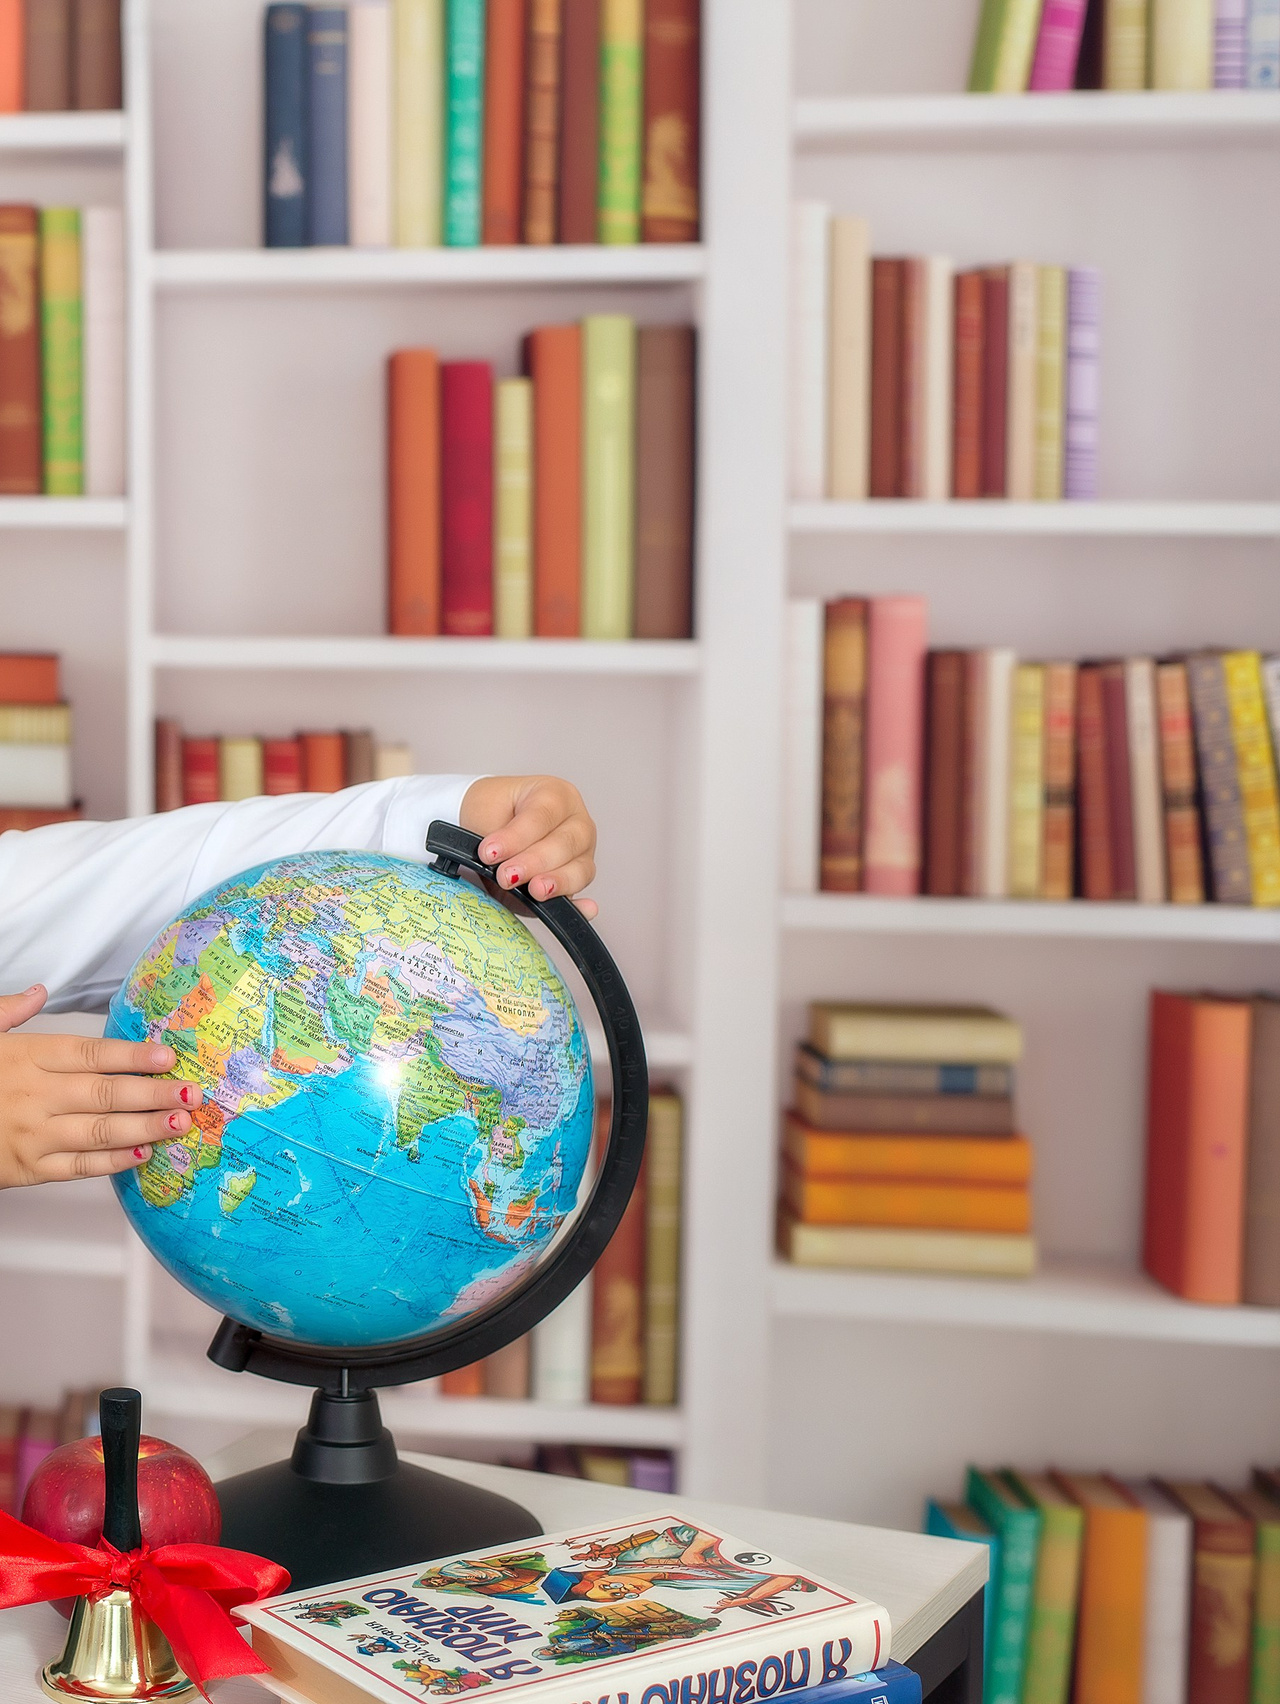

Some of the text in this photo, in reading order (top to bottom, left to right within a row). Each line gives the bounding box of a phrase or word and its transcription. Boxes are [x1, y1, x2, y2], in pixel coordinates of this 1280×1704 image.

[208, 951, 237, 975] ЛИВИЯ
[424, 952, 442, 962] АСТАНА
[393, 952, 456, 986] КАЗАХСТАН
[364, 978, 390, 994] ТУРКМЕНИЯ
[383, 970, 410, 997] УЗБЕКИСТАН
[234, 986, 259, 1006] ЕГИПЕТ
[306, 990, 318, 1000] ИРАК
[274, 1001, 306, 1020] САУДОВСКАЯ
[332, 997, 370, 1020] ИРАН
[496, 1004, 536, 1018] МОНГОЛИЯ
[615, 1005, 631, 1029] 40
[206, 1018, 230, 1036] СУДАН
[376, 1020, 408, 1037] АФГАНИСТАН
[433, 1022, 465, 1037] ТАДЖИКИСТАН
[290, 1034, 310, 1048] АРАВИЯ
[405, 1076, 455, 1098] ИНДИЯ
[246, 1094, 270, 1108] СОМАЛИ
[362, 1588, 543, 1680] Я ПОЗНАЮ
[444, 1604, 543, 1645] МИР
[365, 1620, 441, 1664] ФИЛОСОФИЯ
[819, 1637, 852, 1686] Я
